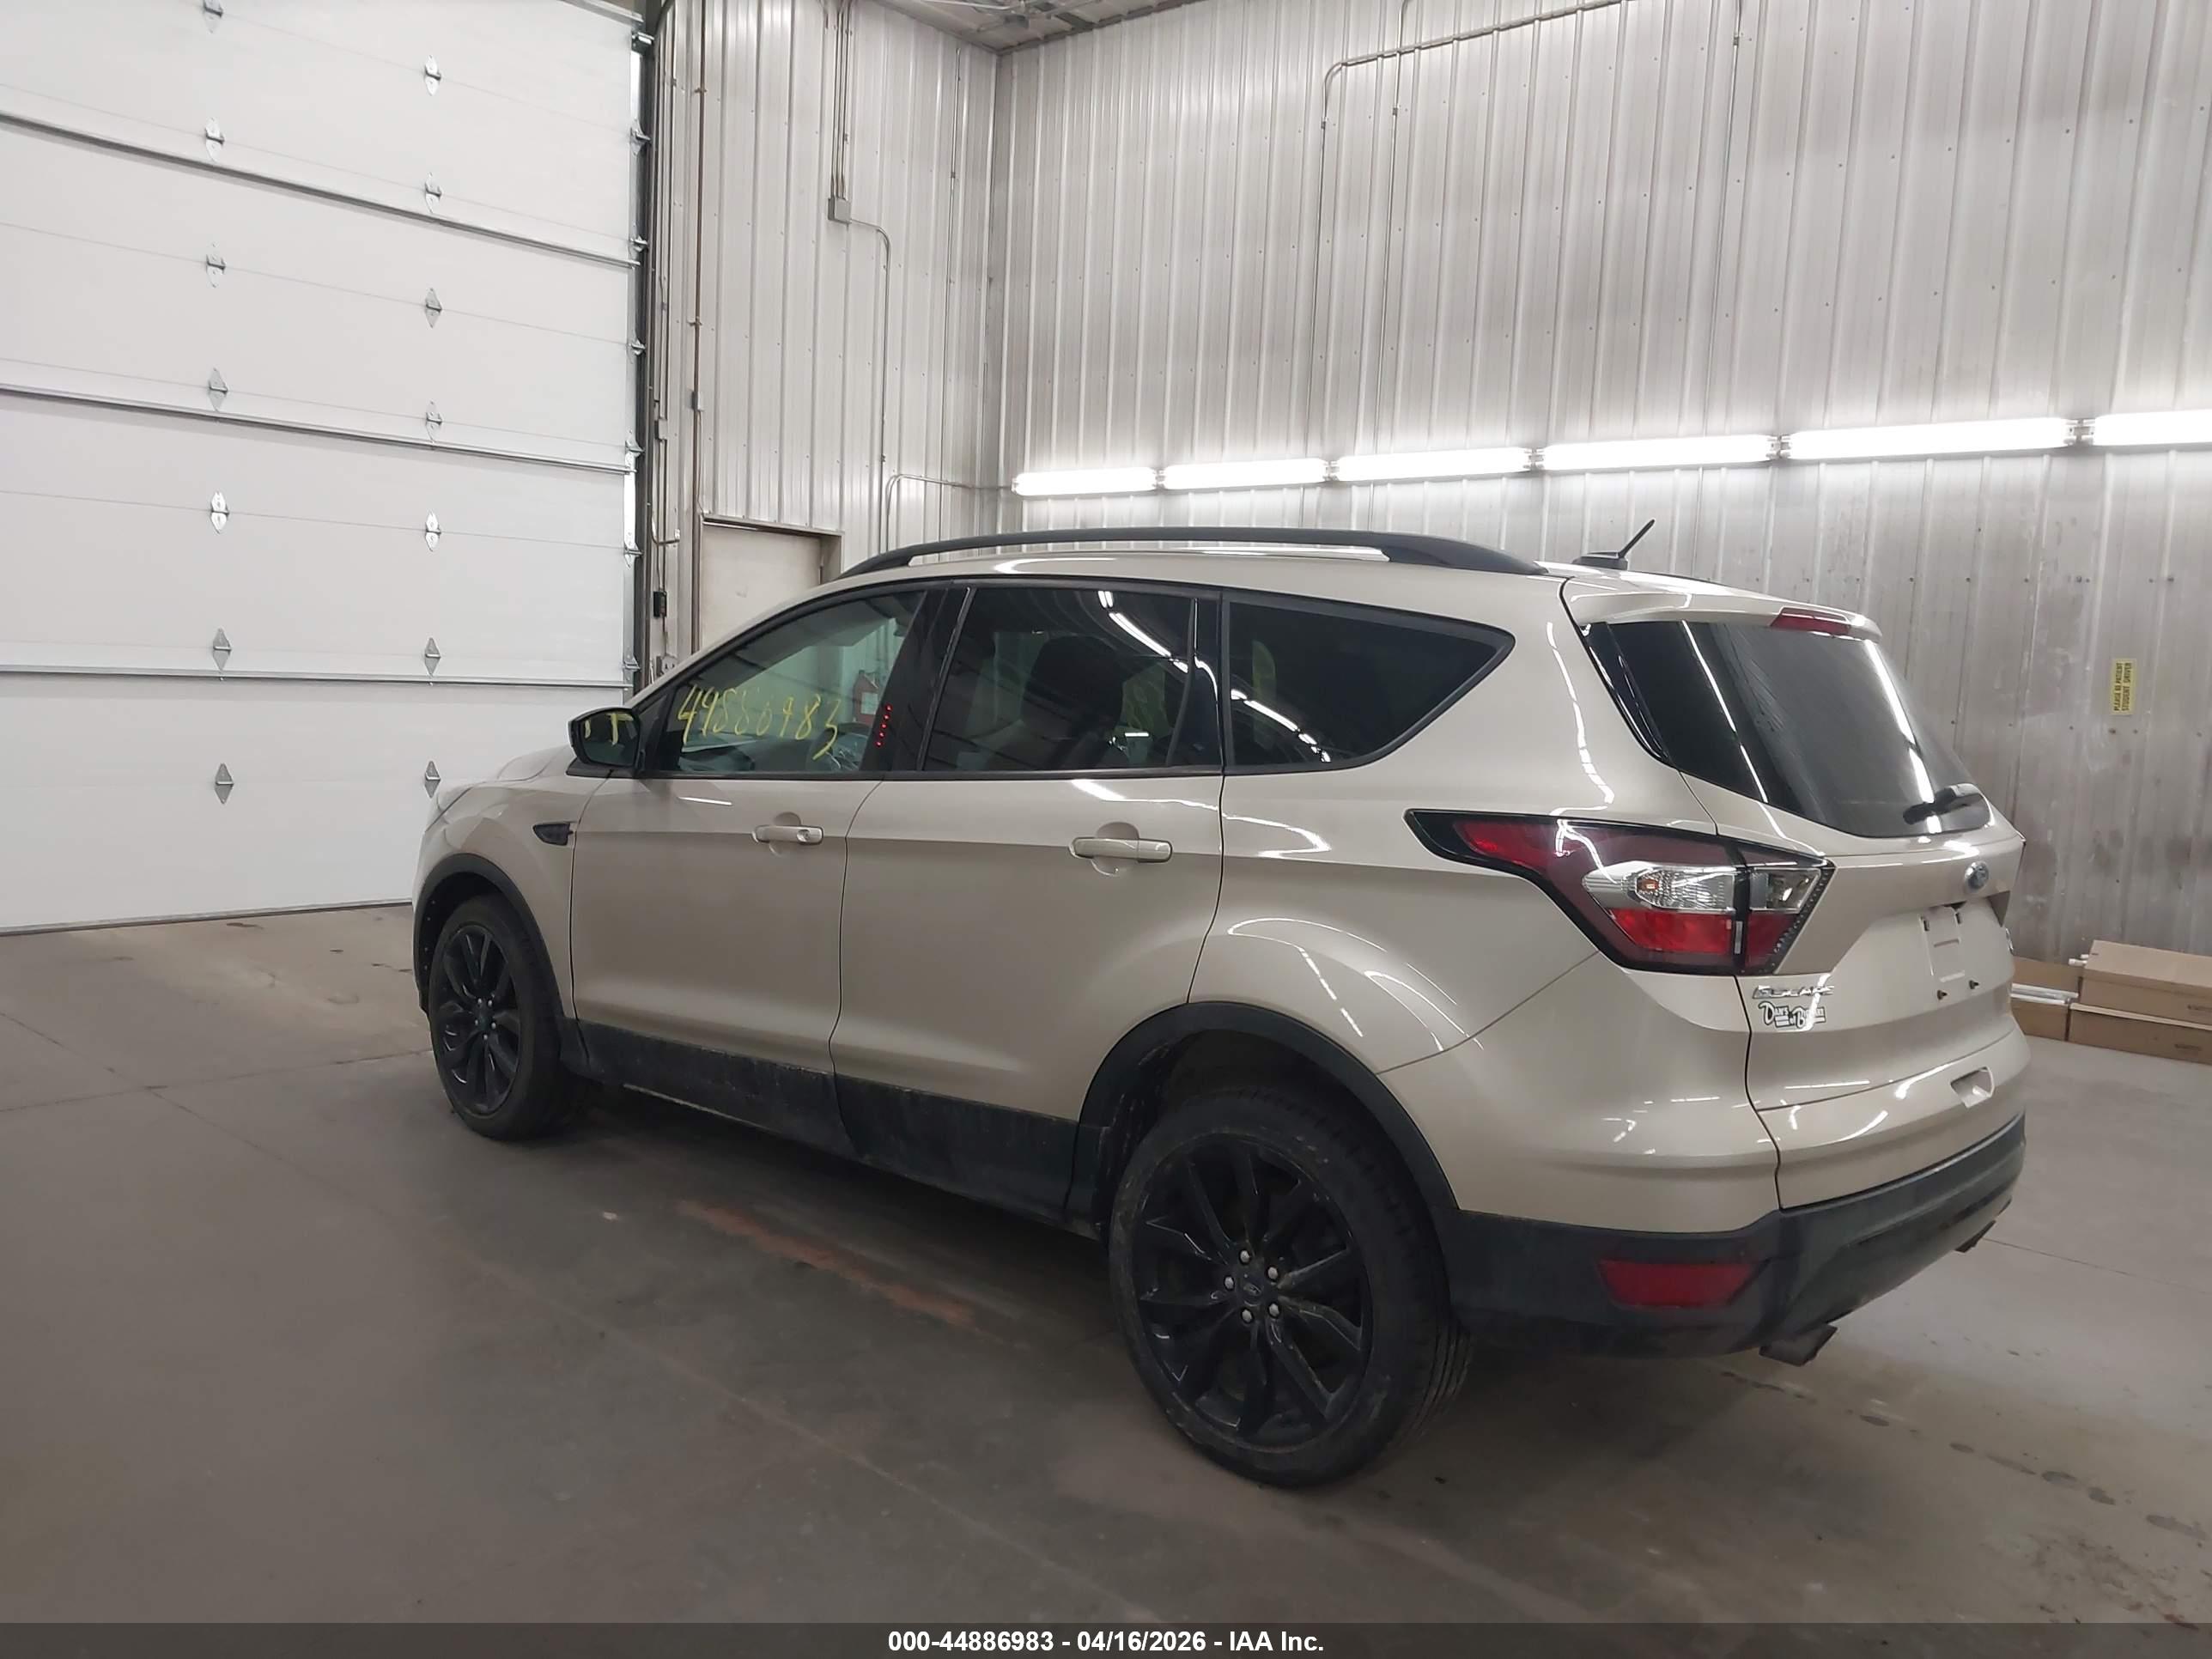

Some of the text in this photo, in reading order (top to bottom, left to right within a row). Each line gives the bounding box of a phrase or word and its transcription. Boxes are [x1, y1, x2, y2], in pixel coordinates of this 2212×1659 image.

[2115, 663, 2124, 684] PATIENT
[2122, 663, 2132, 711] STUDENT DRIVER
